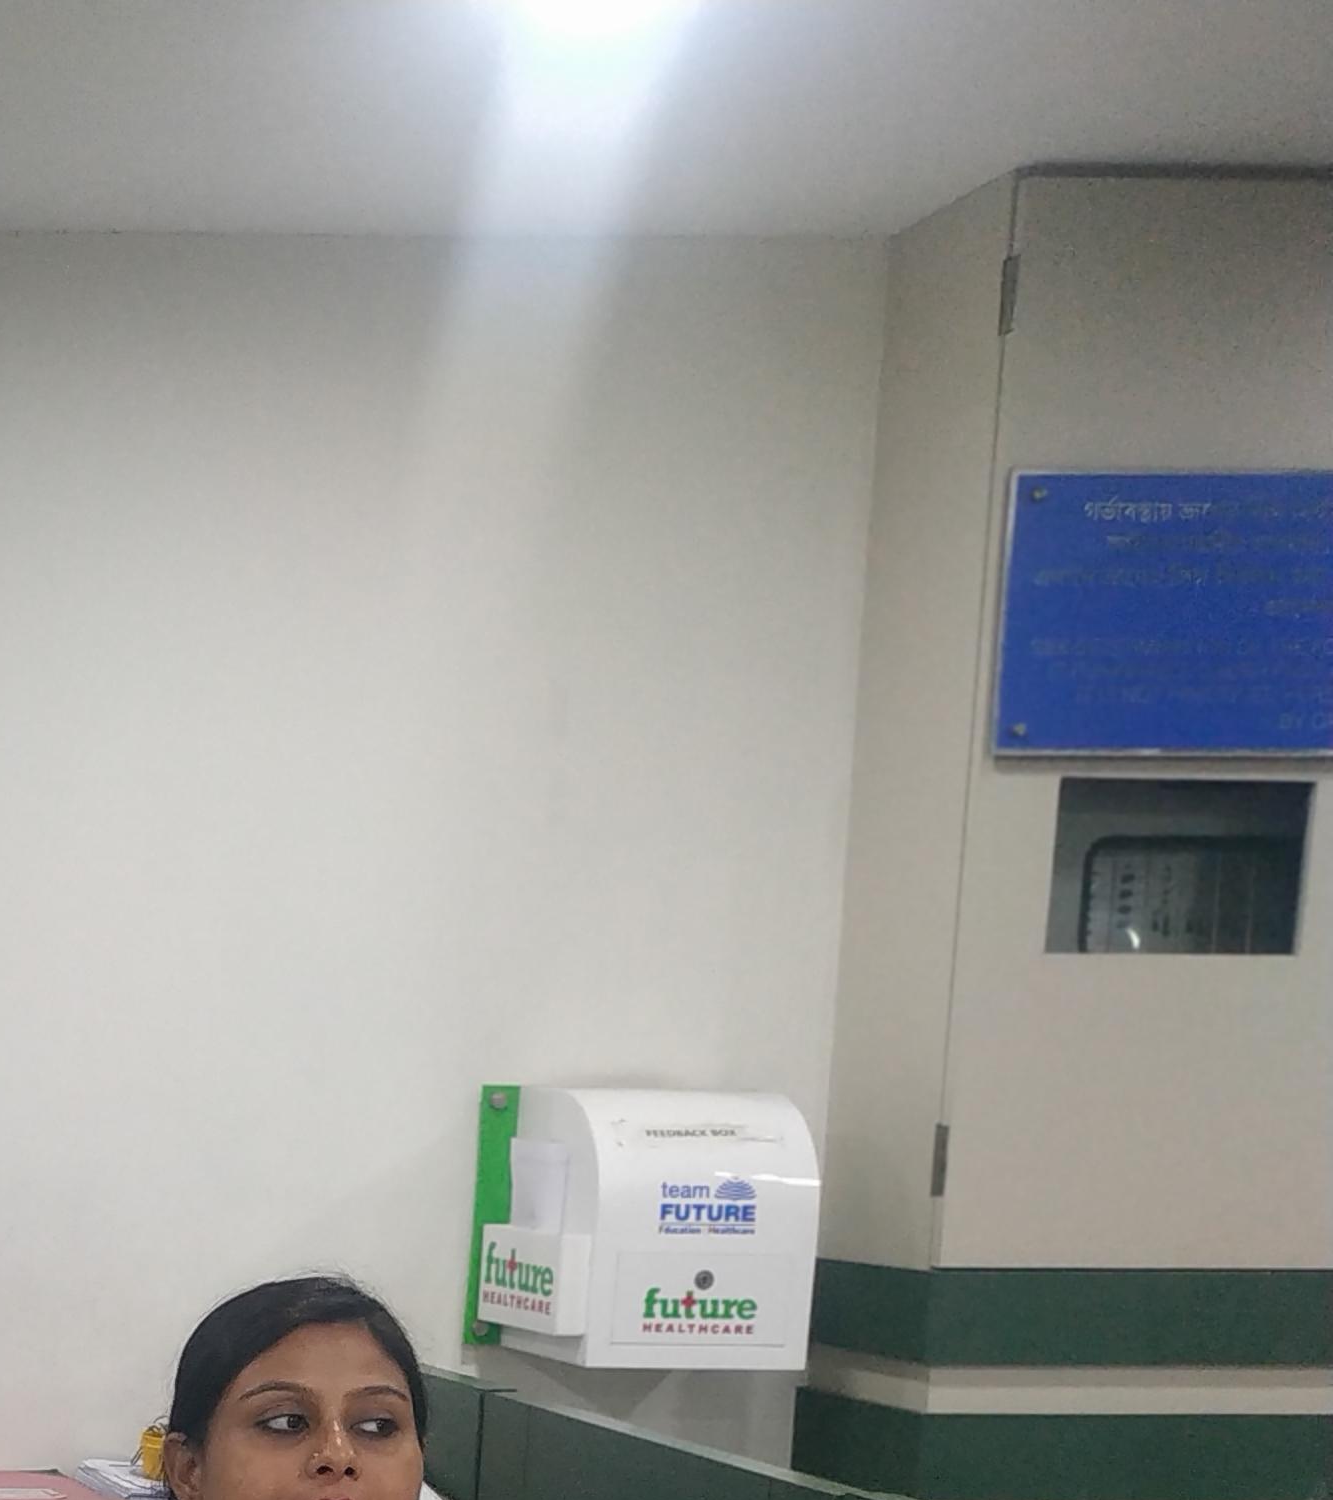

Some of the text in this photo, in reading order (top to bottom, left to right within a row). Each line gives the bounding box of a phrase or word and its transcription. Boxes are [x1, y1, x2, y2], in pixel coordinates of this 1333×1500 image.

[645, 1129, 708, 1137] FEEDBACK
[661, 1182, 710, 1199] team
[659, 1203, 757, 1223] FUTURE
[658, 1225, 756, 1235] Education Healthcare
[484, 1241, 554, 1297] future
[482, 1289, 552, 1316] HEALTHCARE
[642, 1287, 758, 1320] future
[642, 1323, 754, 1334] HEALTHCARE
